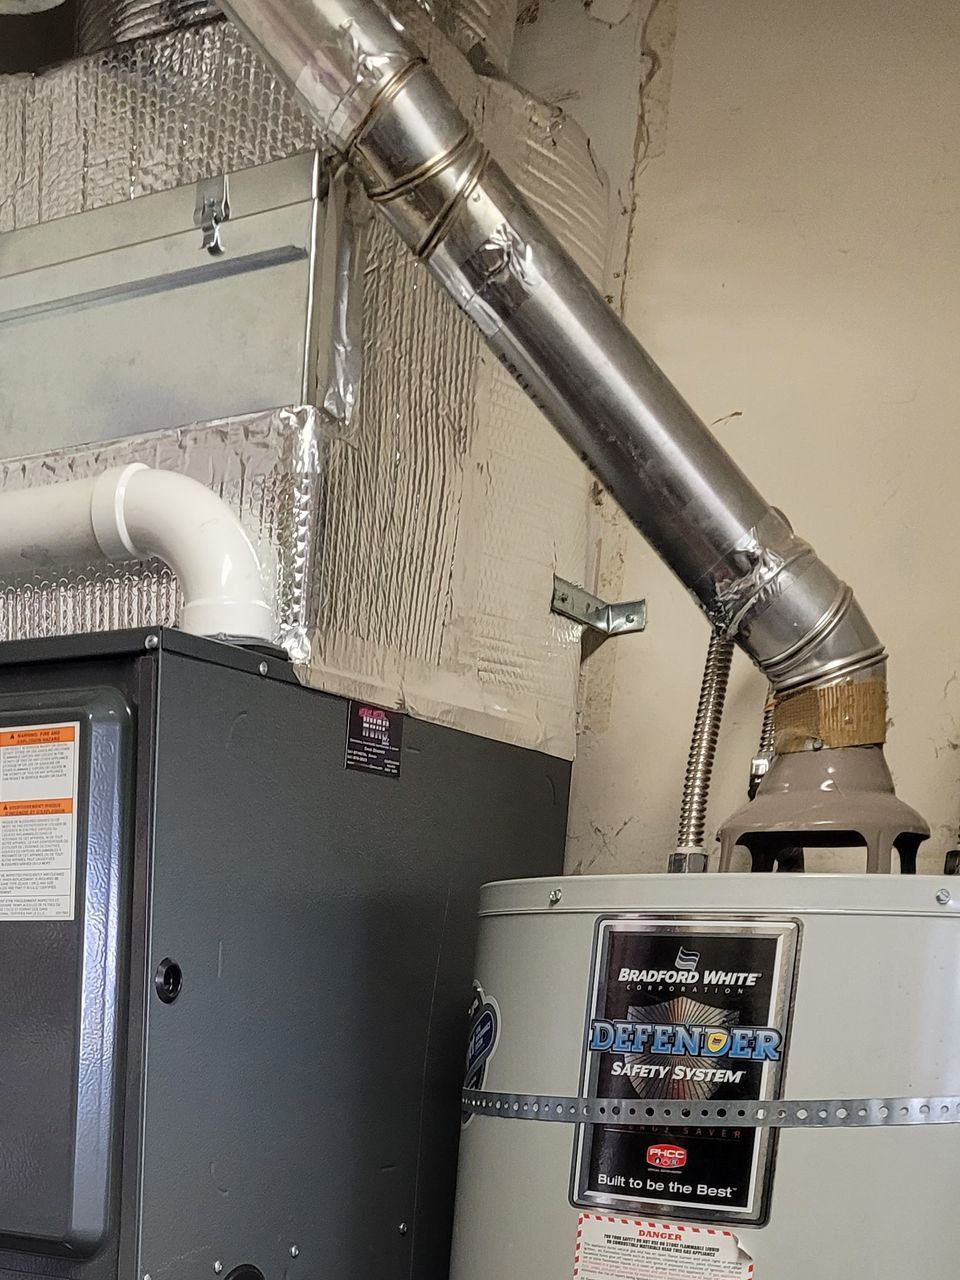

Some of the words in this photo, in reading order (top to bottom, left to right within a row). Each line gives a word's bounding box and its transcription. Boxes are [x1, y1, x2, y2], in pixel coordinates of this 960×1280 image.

[618, 968, 699, 984] BRADFORD
[703, 970, 757, 986] WHITE
[626, 984, 744, 994] CORPORATION
[591, 1020, 781, 1061] DEFENDER
[611, 1062, 671, 1079] SAFETY
[672, 1065, 744, 1084] SYSTEM
[649, 1148, 685, 1158] PHCC
[598, 1173, 625, 1187] Built
[629, 1176, 642, 1188] to
[647, 1179, 664, 1191] be
[669, 1182, 692, 1194] the
[638, 1230, 683, 1241] DANGER
